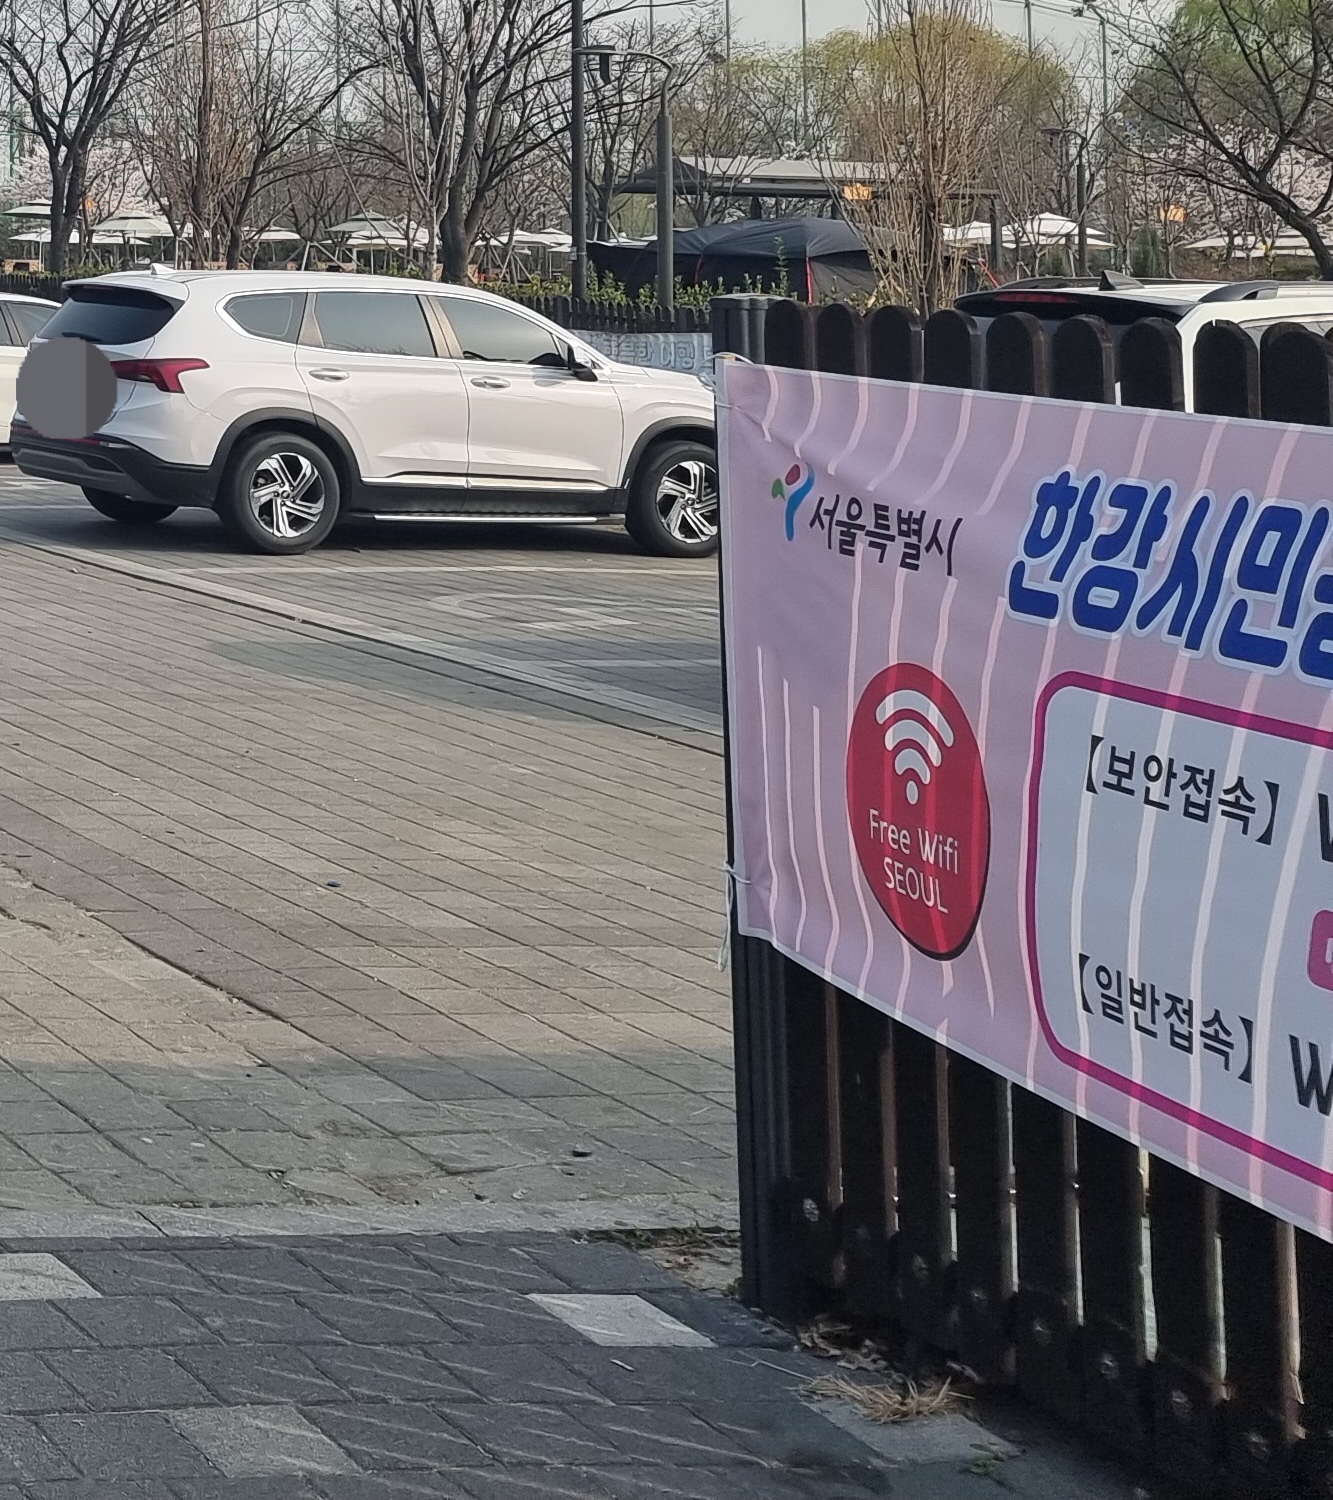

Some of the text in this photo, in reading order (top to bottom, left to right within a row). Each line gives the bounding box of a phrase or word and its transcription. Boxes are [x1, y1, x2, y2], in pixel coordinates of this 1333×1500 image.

[809, 494, 964, 577] 서울특별시
[869, 809, 960, 875] Free Wifi
[884, 856, 949, 915] SEOUL
